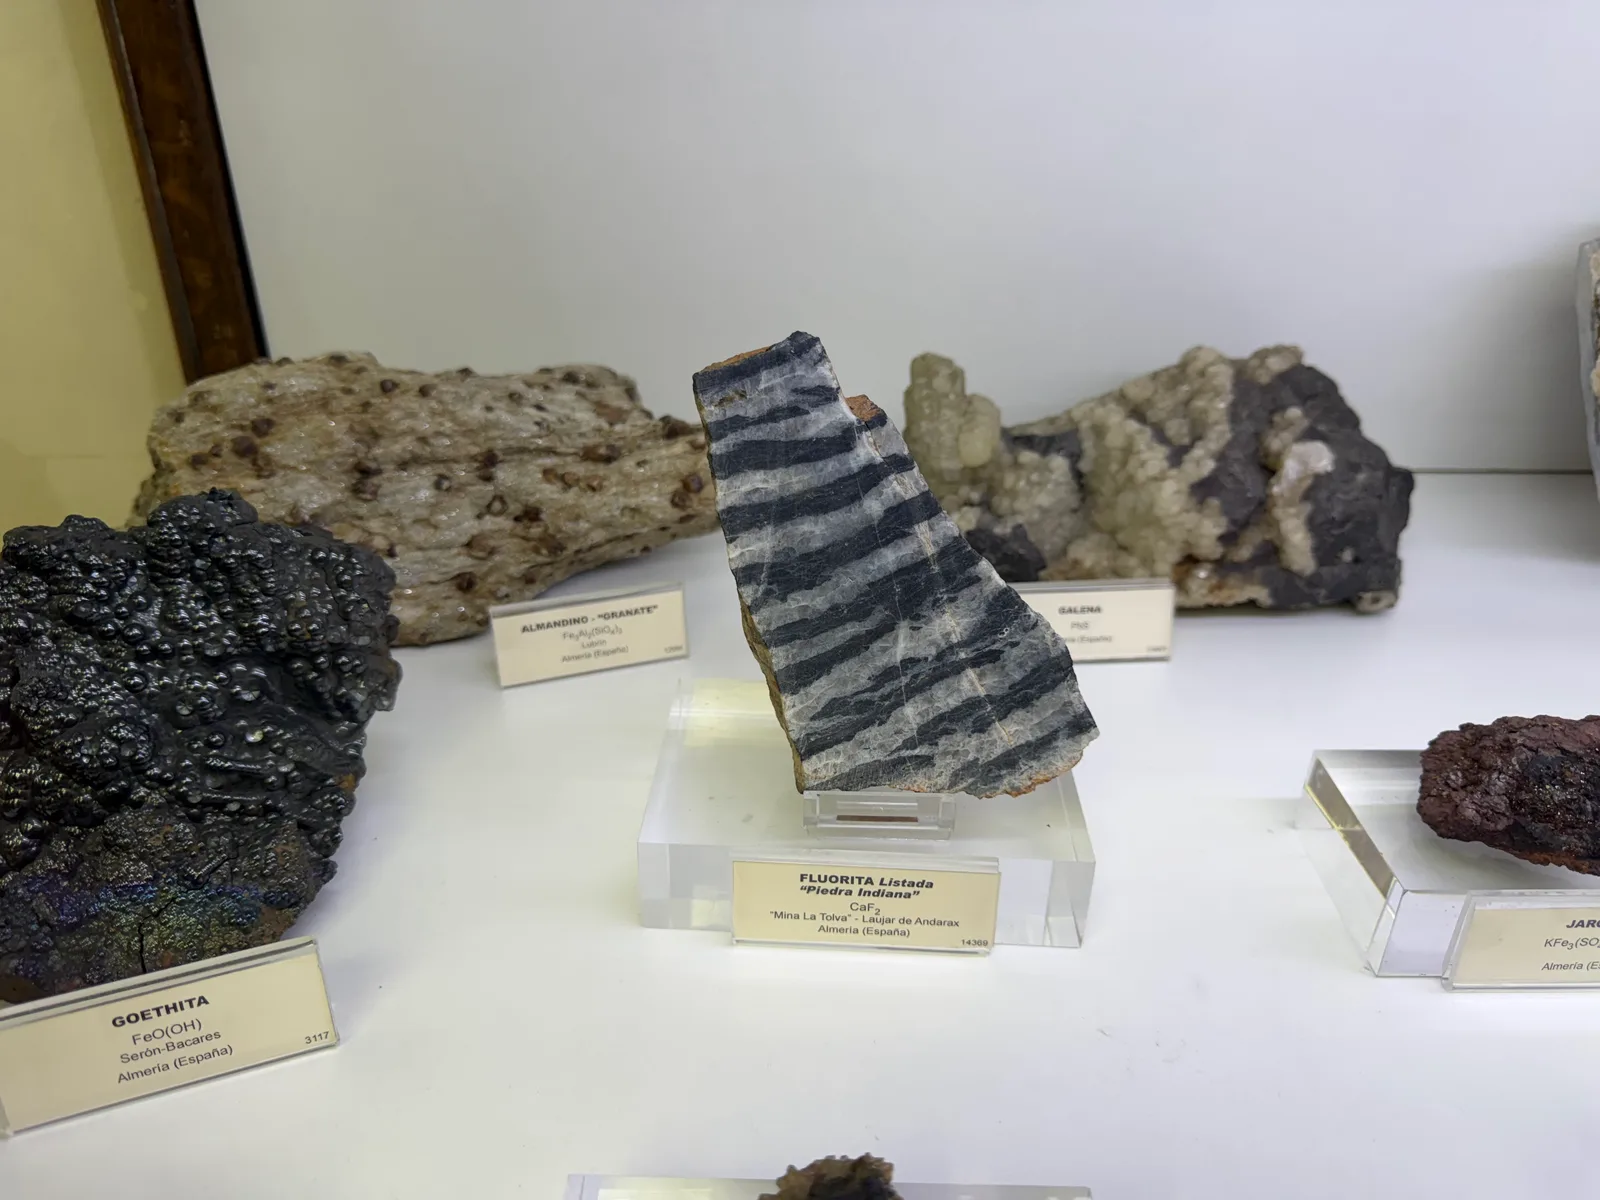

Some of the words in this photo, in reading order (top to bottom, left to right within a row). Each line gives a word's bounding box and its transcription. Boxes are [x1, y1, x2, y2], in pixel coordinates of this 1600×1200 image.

[1058, 606, 1102, 614] GALENA
[521, 616, 588, 633] ALMANDINO
[800, 873, 874, 886] FLUORITA
[879, 877, 934, 889] Listada
[803, 912, 817, 921] La
[862, 915, 896, 925] Laujar
[898, 916, 912, 925] de
[915, 917, 960, 927] Andarax
[862, 927, 910, 937] (España)
[961, 939, 988, 947] 14369
[1541, 962, 1583, 970] Almería
[111, 995, 210, 1028] GOETHITA
[132, 1019, 202, 1045] FeO(OH)
[305, 1031, 330, 1044] 3117
[120, 1030, 222, 1064] Serón-Bacares
[117, 1062, 170, 1084] Almería
[174, 1044, 233, 1070] (España)
